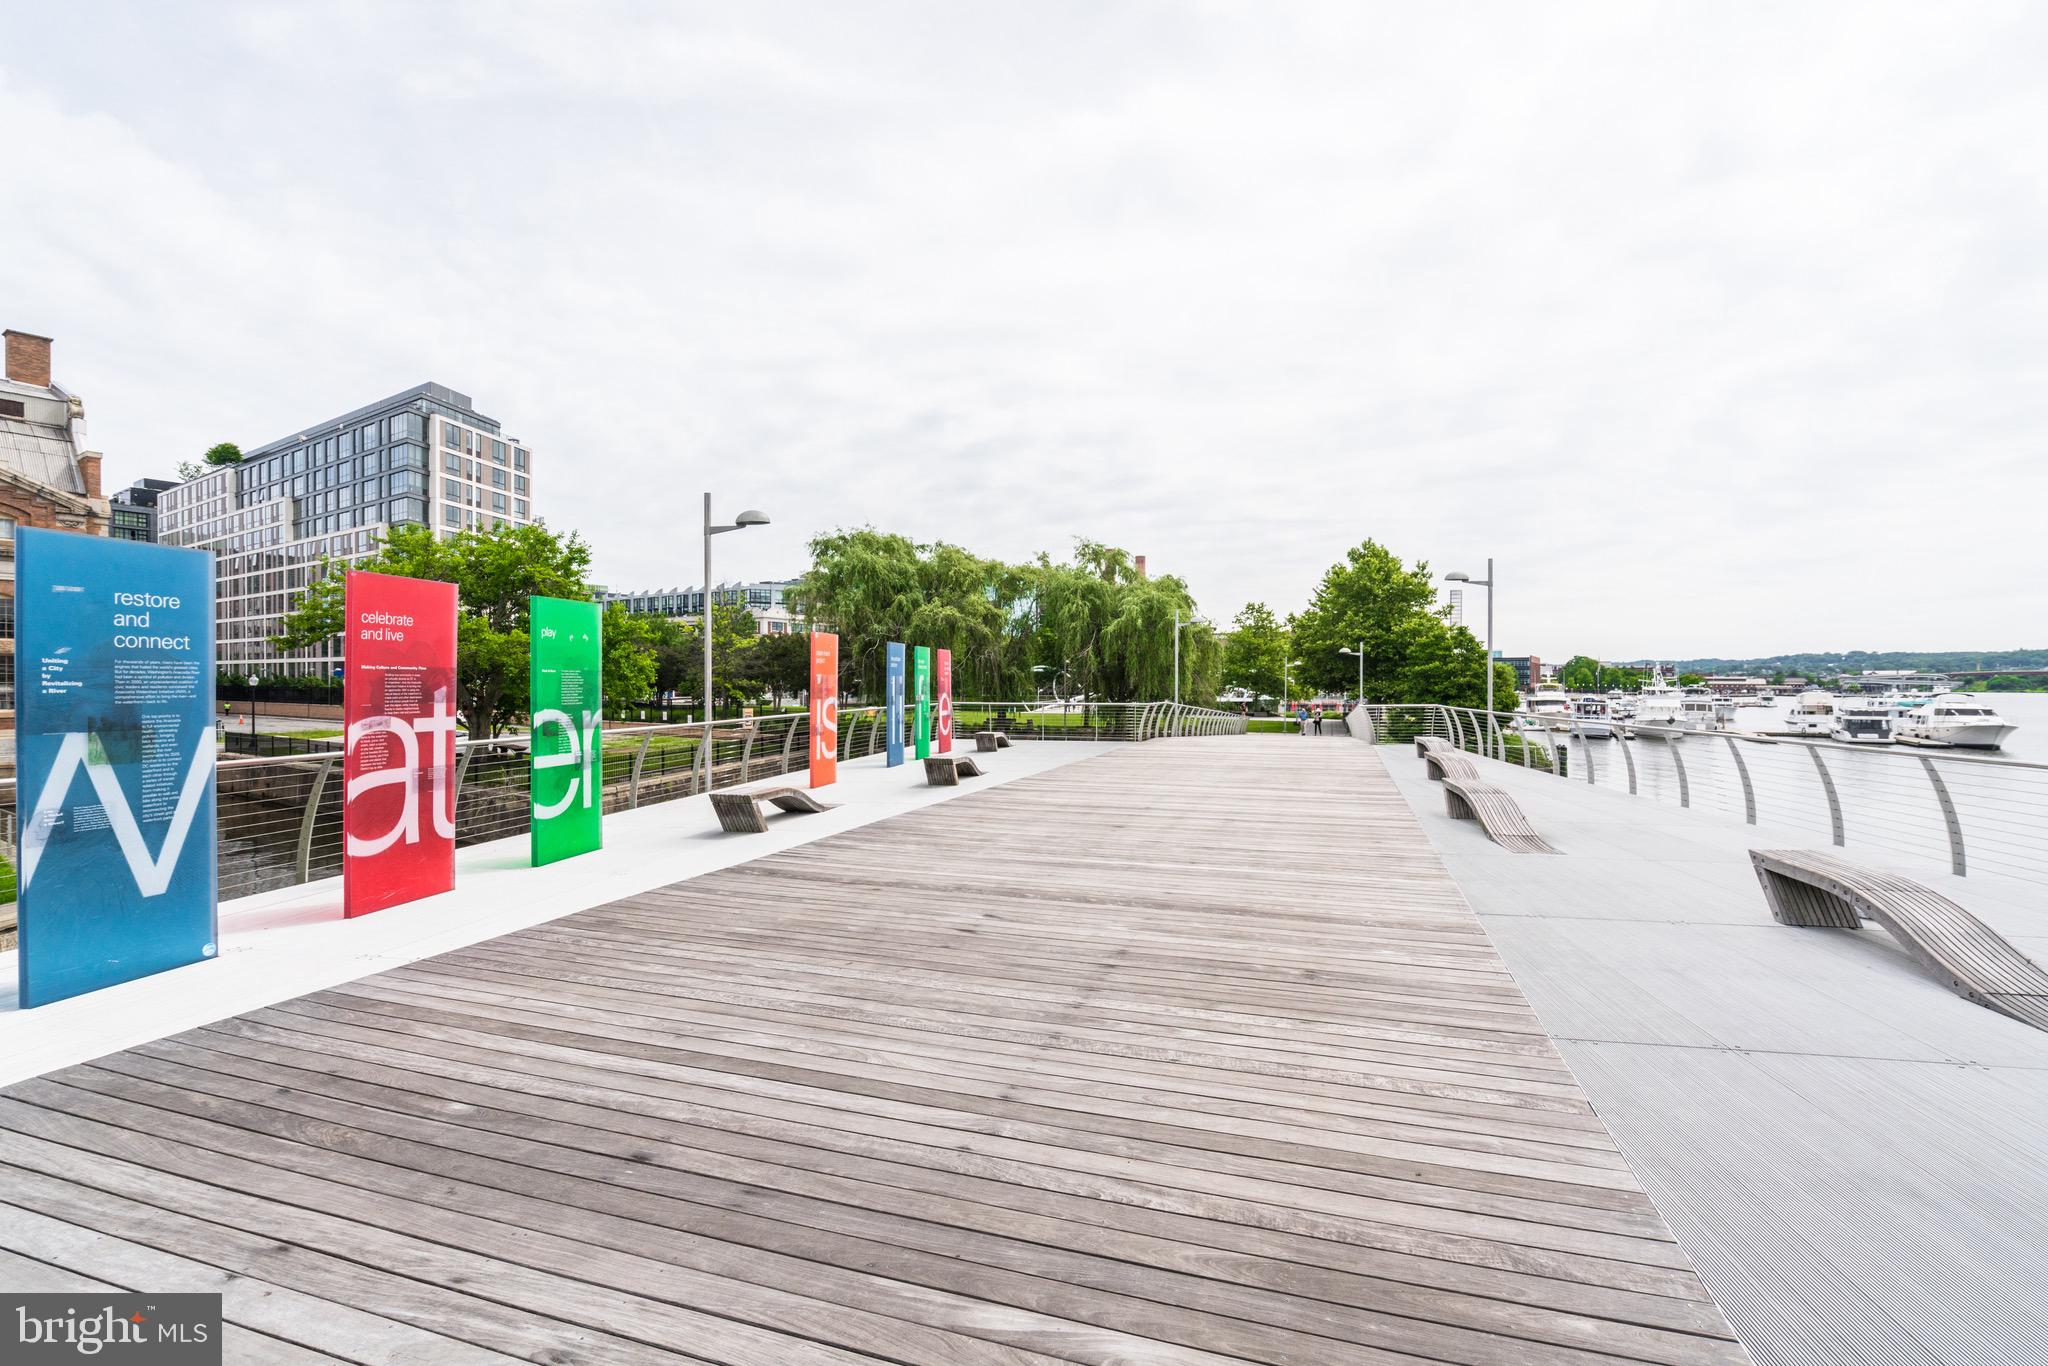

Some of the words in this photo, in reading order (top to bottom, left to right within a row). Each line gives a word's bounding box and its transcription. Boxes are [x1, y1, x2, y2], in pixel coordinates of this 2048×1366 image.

[114, 592, 180, 609] restore
[114, 612, 150, 628] and
[361, 611, 414, 627] celebrate
[360, 628, 383, 641] and
[385, 628, 404, 642] live
[541, 627, 557, 640] play
[114, 635, 191, 650] connect
[816, 674, 837, 760] is
[939, 692, 951, 736] e
[347, 686, 455, 857] at
[534, 708, 602, 820] er
